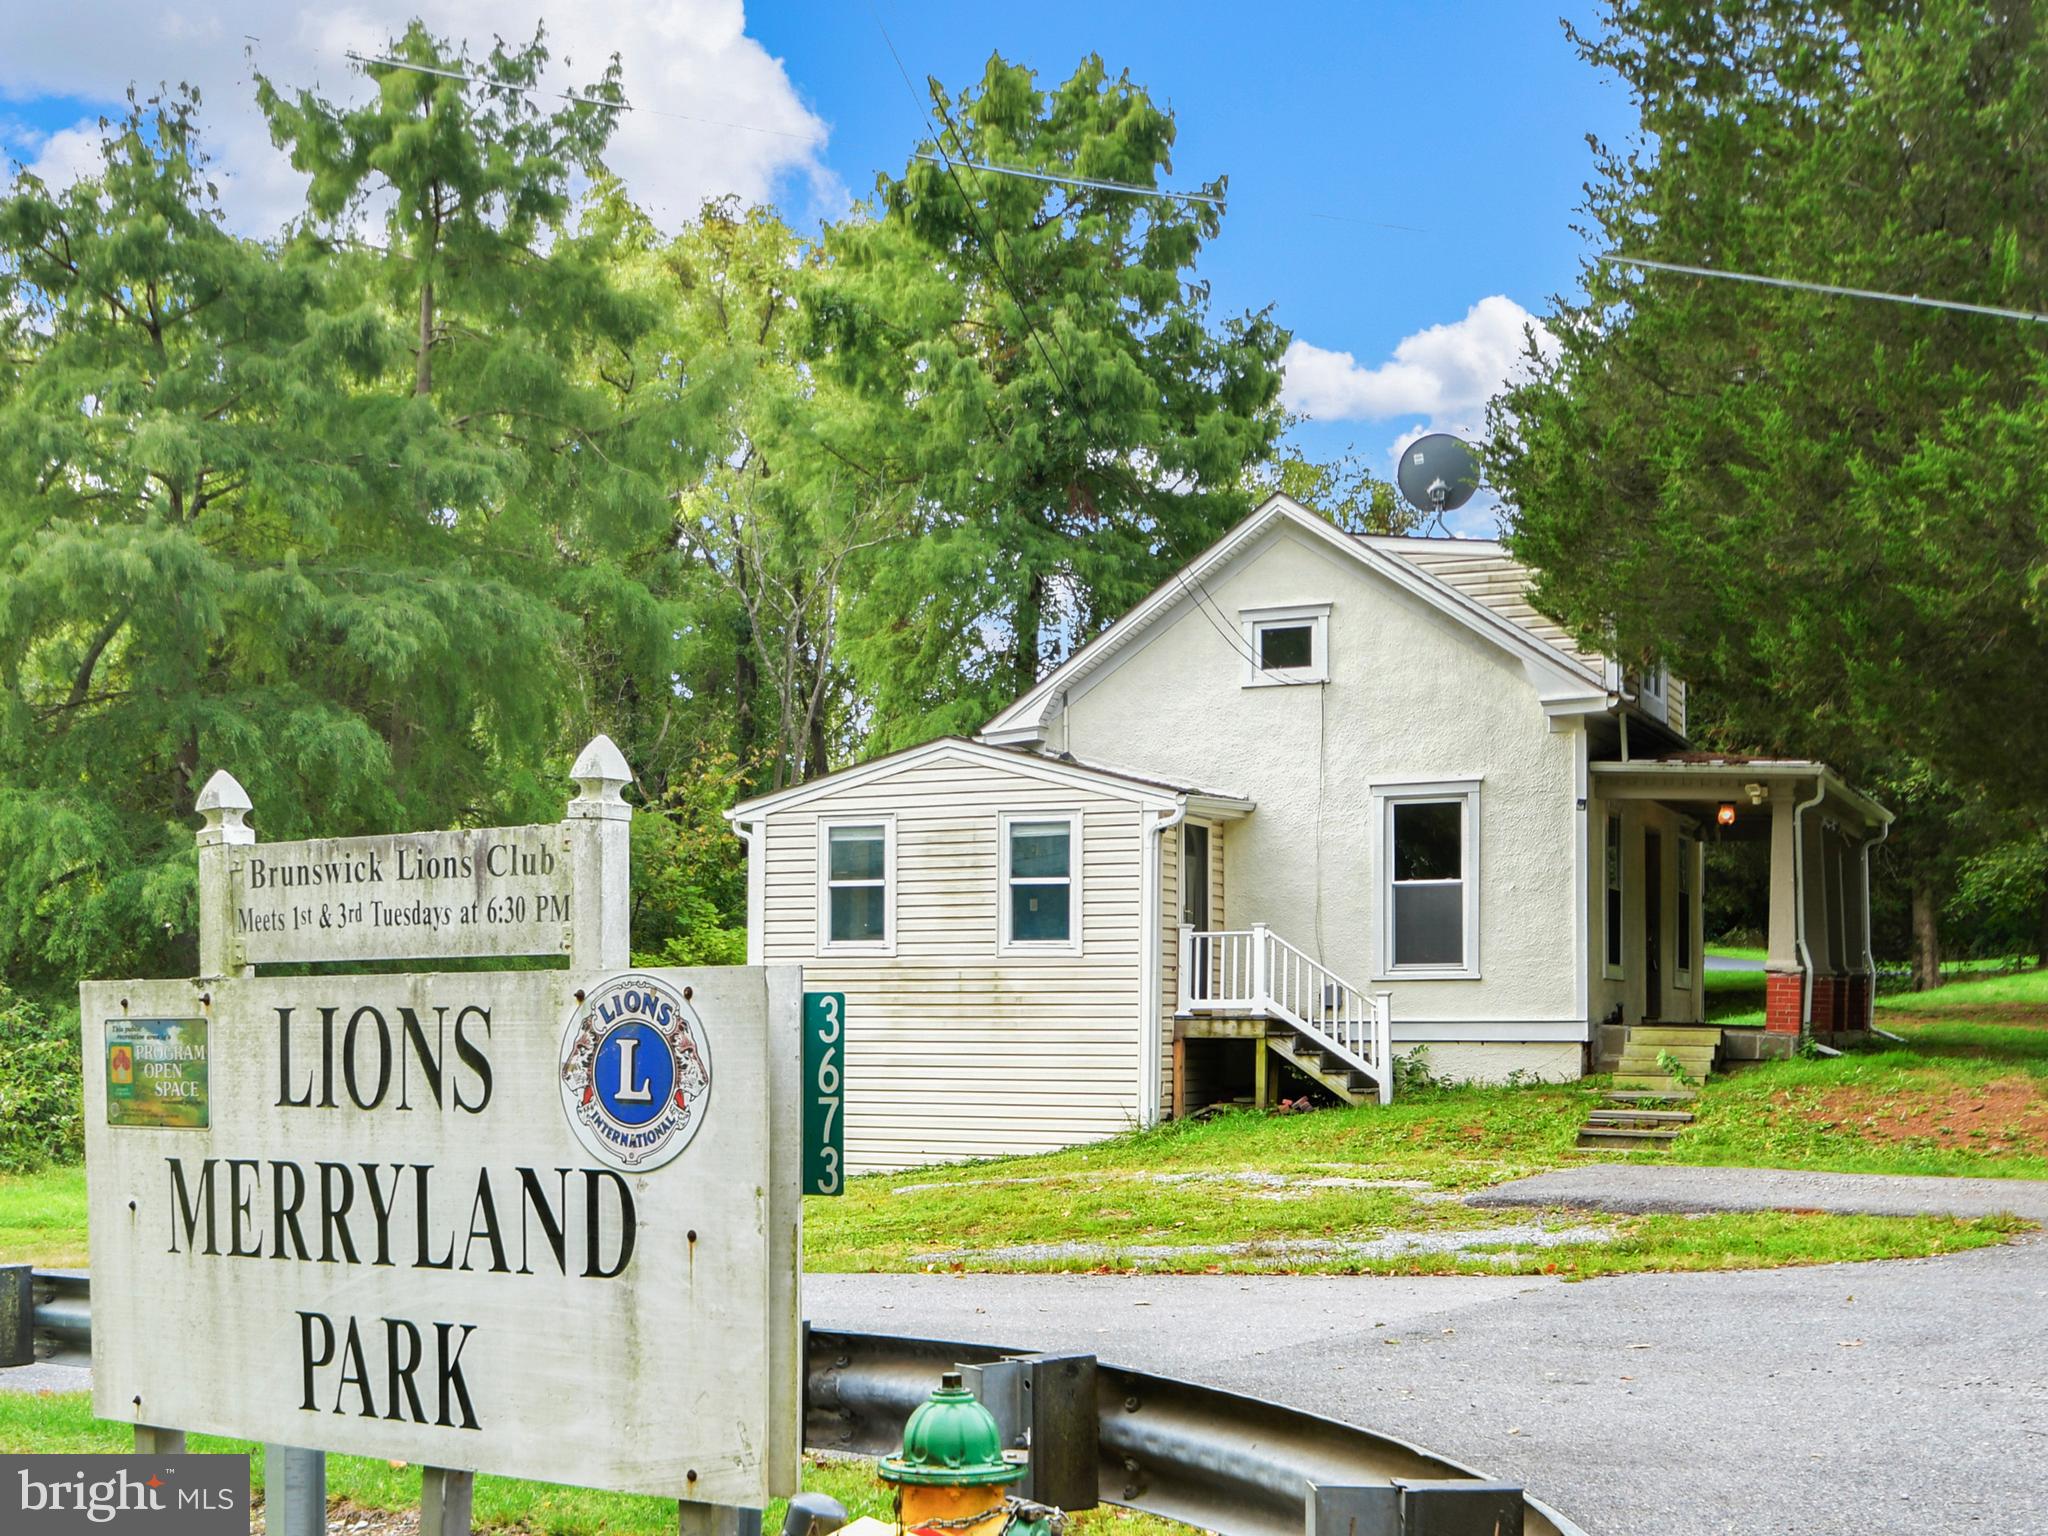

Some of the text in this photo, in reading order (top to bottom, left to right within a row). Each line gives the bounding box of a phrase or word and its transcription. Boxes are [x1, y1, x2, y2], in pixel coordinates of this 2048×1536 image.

[249, 843, 555, 889] Brunswick Lions Club
[238, 894, 571, 934] Meets 1st & 3rd Tuesdays at 6:30 PM
[597, 990, 673, 1026] LIONS
[135, 1044, 205, 1061] PROGRAM
[143, 1063, 182, 1079] OPEN
[274, 1004, 493, 1114] LIONS
[614, 1038, 653, 1103] L
[154, 1080, 200, 1097] SPACE
[817, 994, 840, 1194] 3673
[590, 1112, 676, 1148] INTERNATIONAL
[164, 1157, 637, 1279] MERRYLAND
[295, 1310, 483, 1431] PARK
